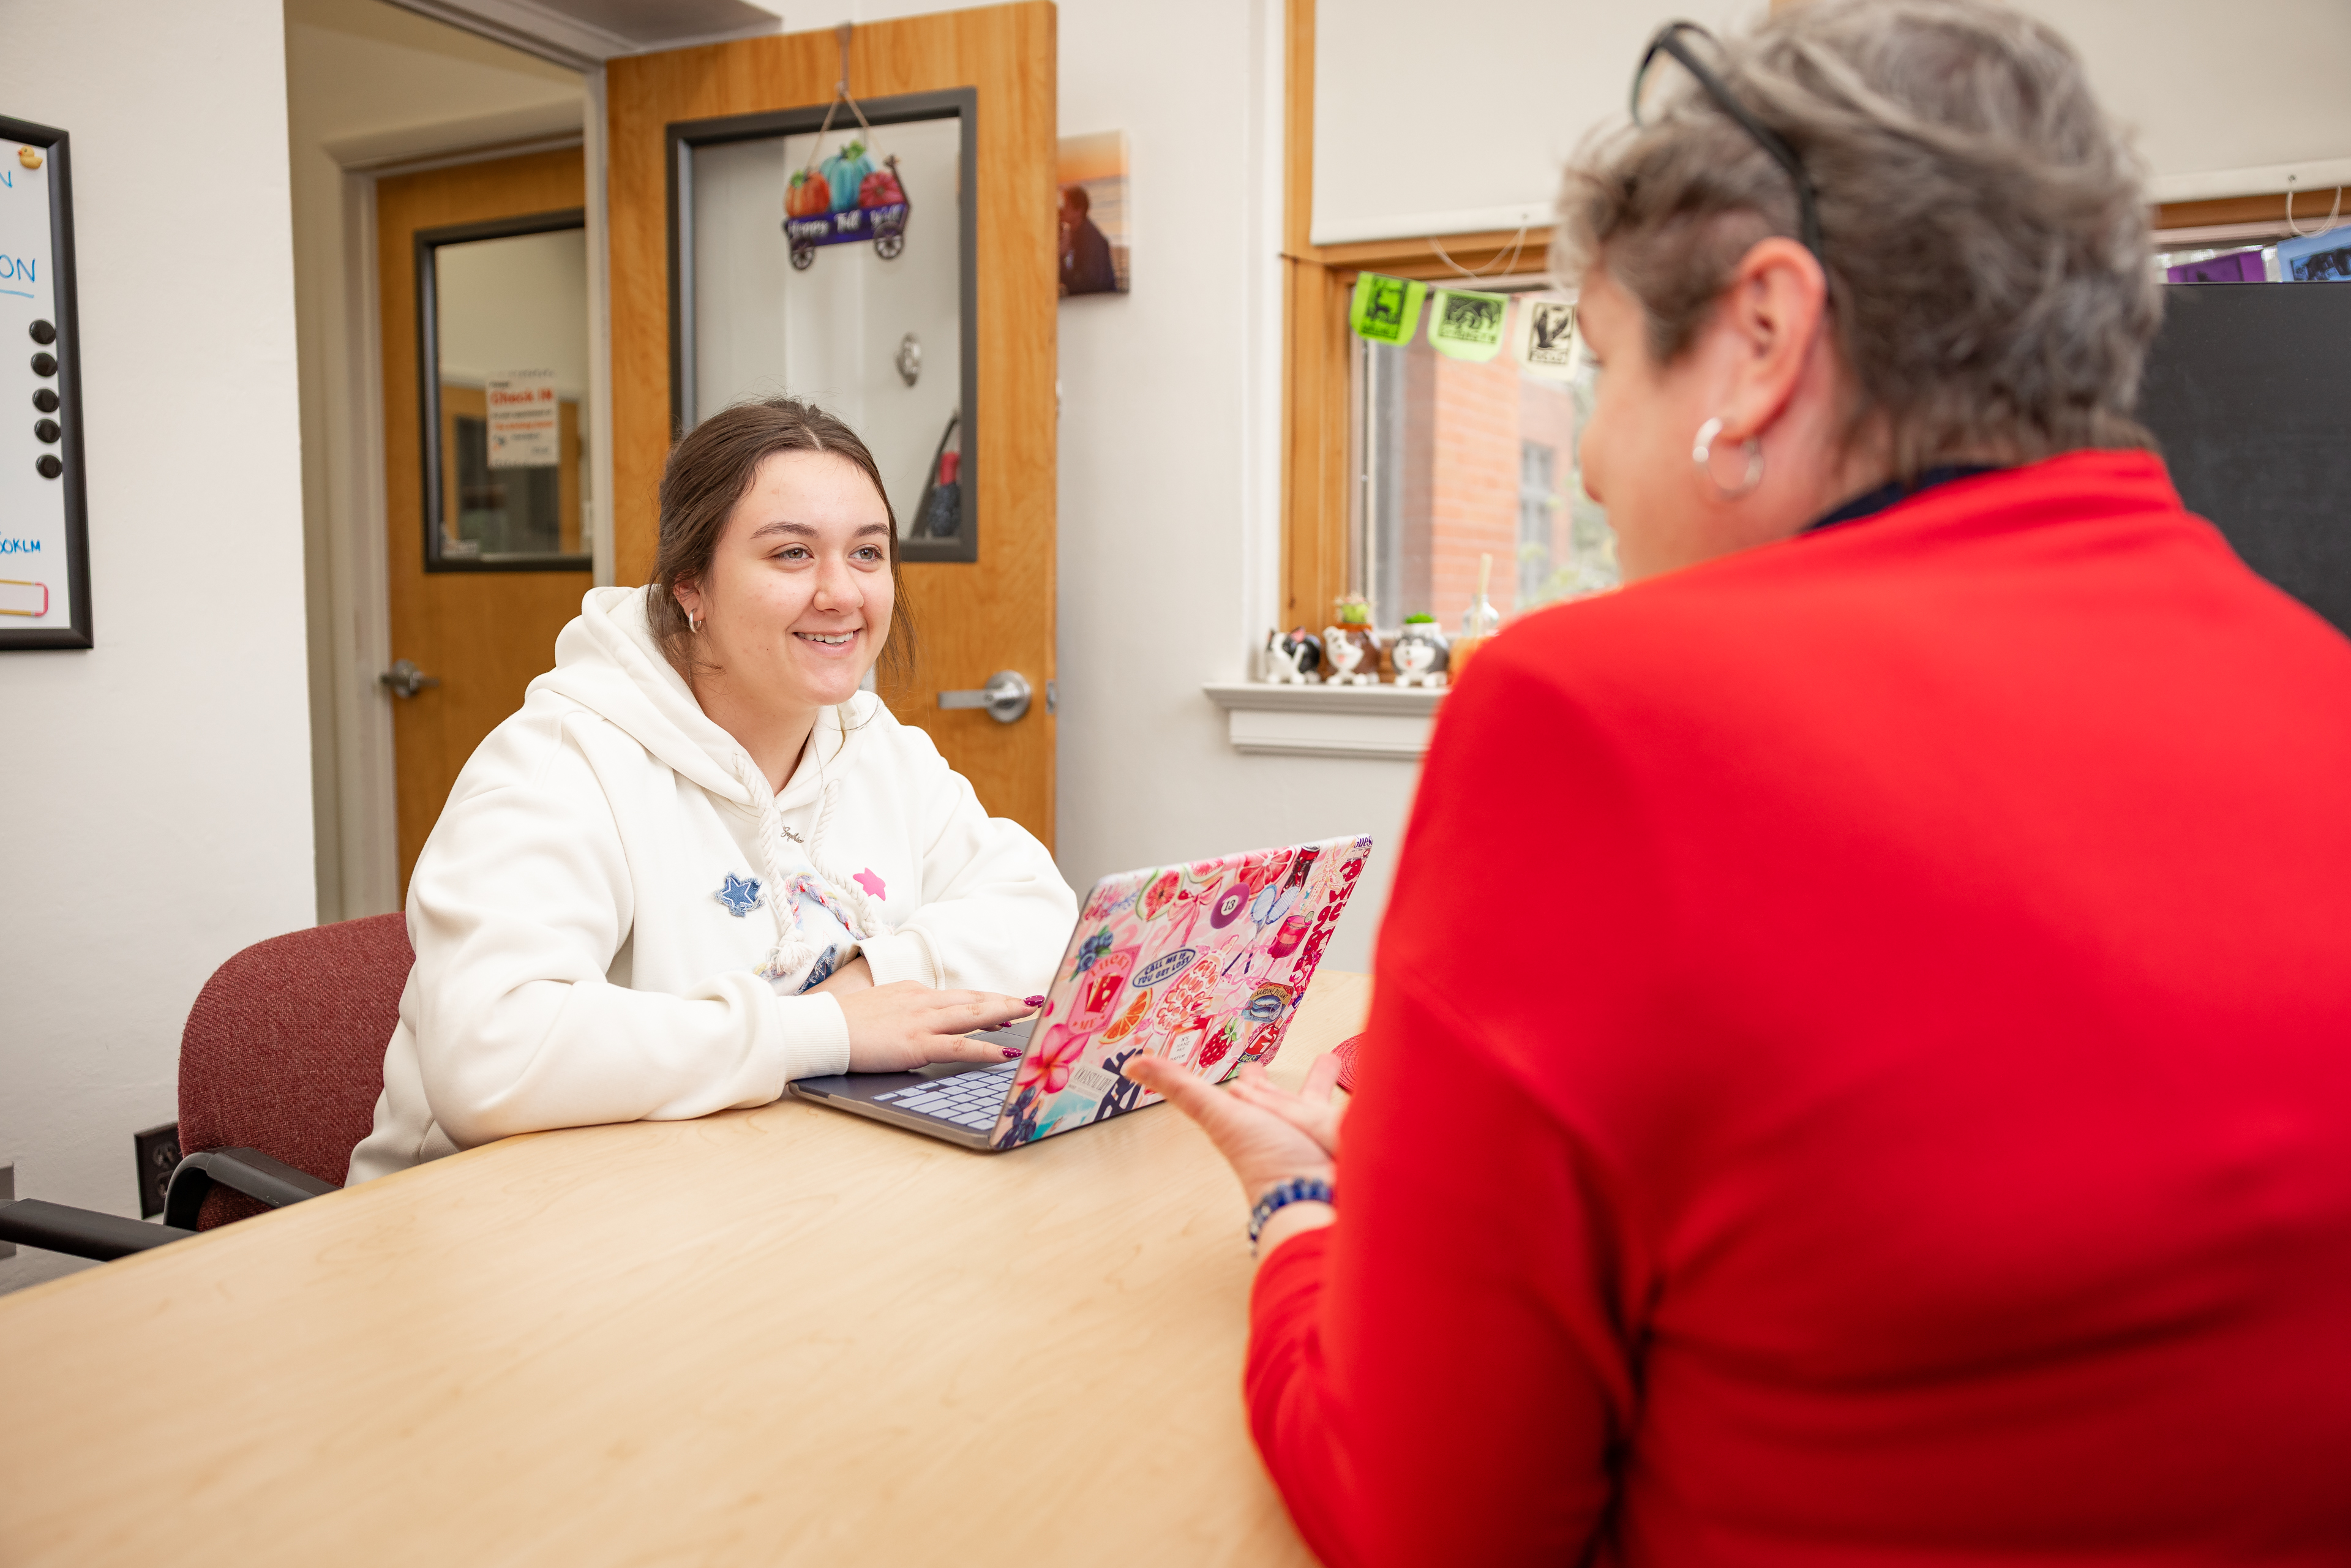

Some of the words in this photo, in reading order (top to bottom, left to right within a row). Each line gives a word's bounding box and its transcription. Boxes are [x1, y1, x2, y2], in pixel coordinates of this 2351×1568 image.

[1223, 899, 1236, 911] 13
[1090, 955, 1130, 977] LUCKY
[1138, 973, 1153, 984] YOU
[1155, 967, 1170, 978] GET
[1172, 956, 1190, 970] LOST
[1144, 961, 1162, 975] CALL
[1166, 955, 1177, 964] ME
[1256, 988, 1275, 996] SARDINE
[1073, 1067, 1103, 1088] COASTAL
[1096, 1076, 1114, 1092] LIFE
